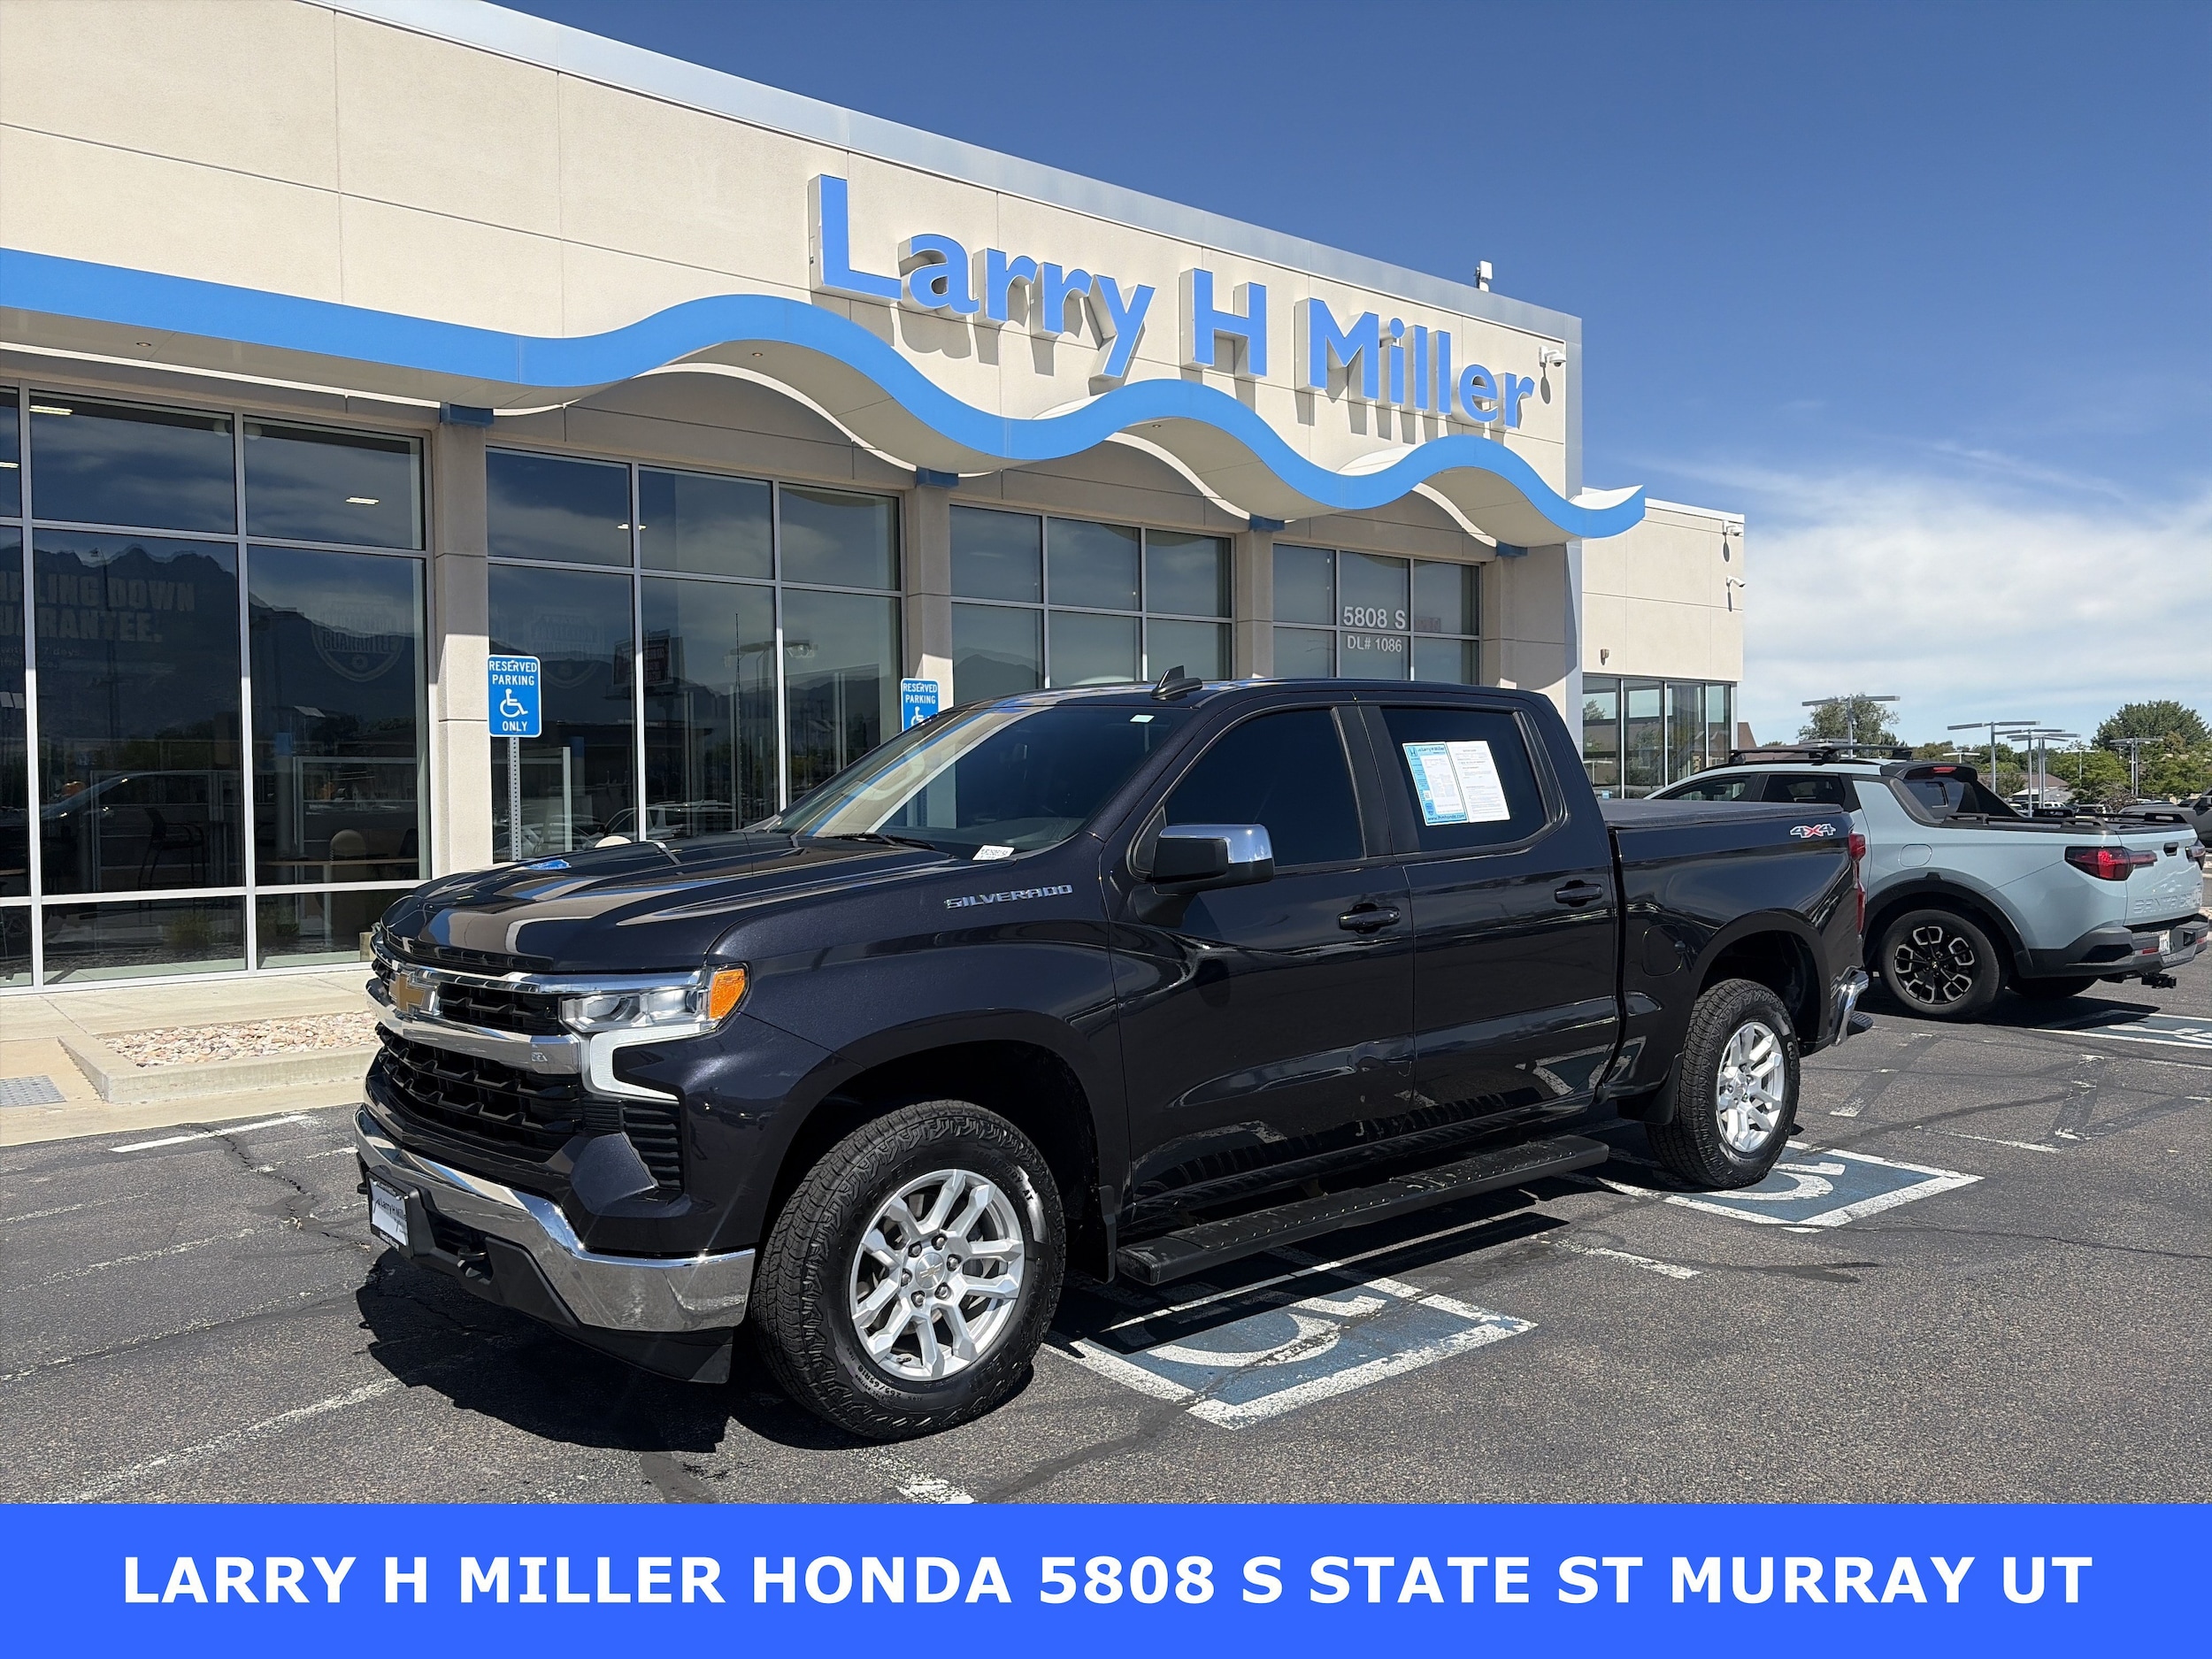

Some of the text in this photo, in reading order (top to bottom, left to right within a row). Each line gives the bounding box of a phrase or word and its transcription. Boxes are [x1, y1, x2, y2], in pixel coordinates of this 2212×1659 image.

[812, 174, 1535, 430] Larry H Miller
[107, 576, 195, 612] DOWN
[1343, 606, 1387, 628] 5808
[1394, 610, 1406, 629] S
[1347, 635, 1402, 653] DL# 1086
[488, 660, 537, 672] RESERVED
[492, 674, 534, 686] PARKING
[902, 682, 938, 693] RESERVED
[905, 695, 936, 704] PARKING
[502, 721, 527, 732] ONLY
[944, 885, 1073, 909] SILVERADO
